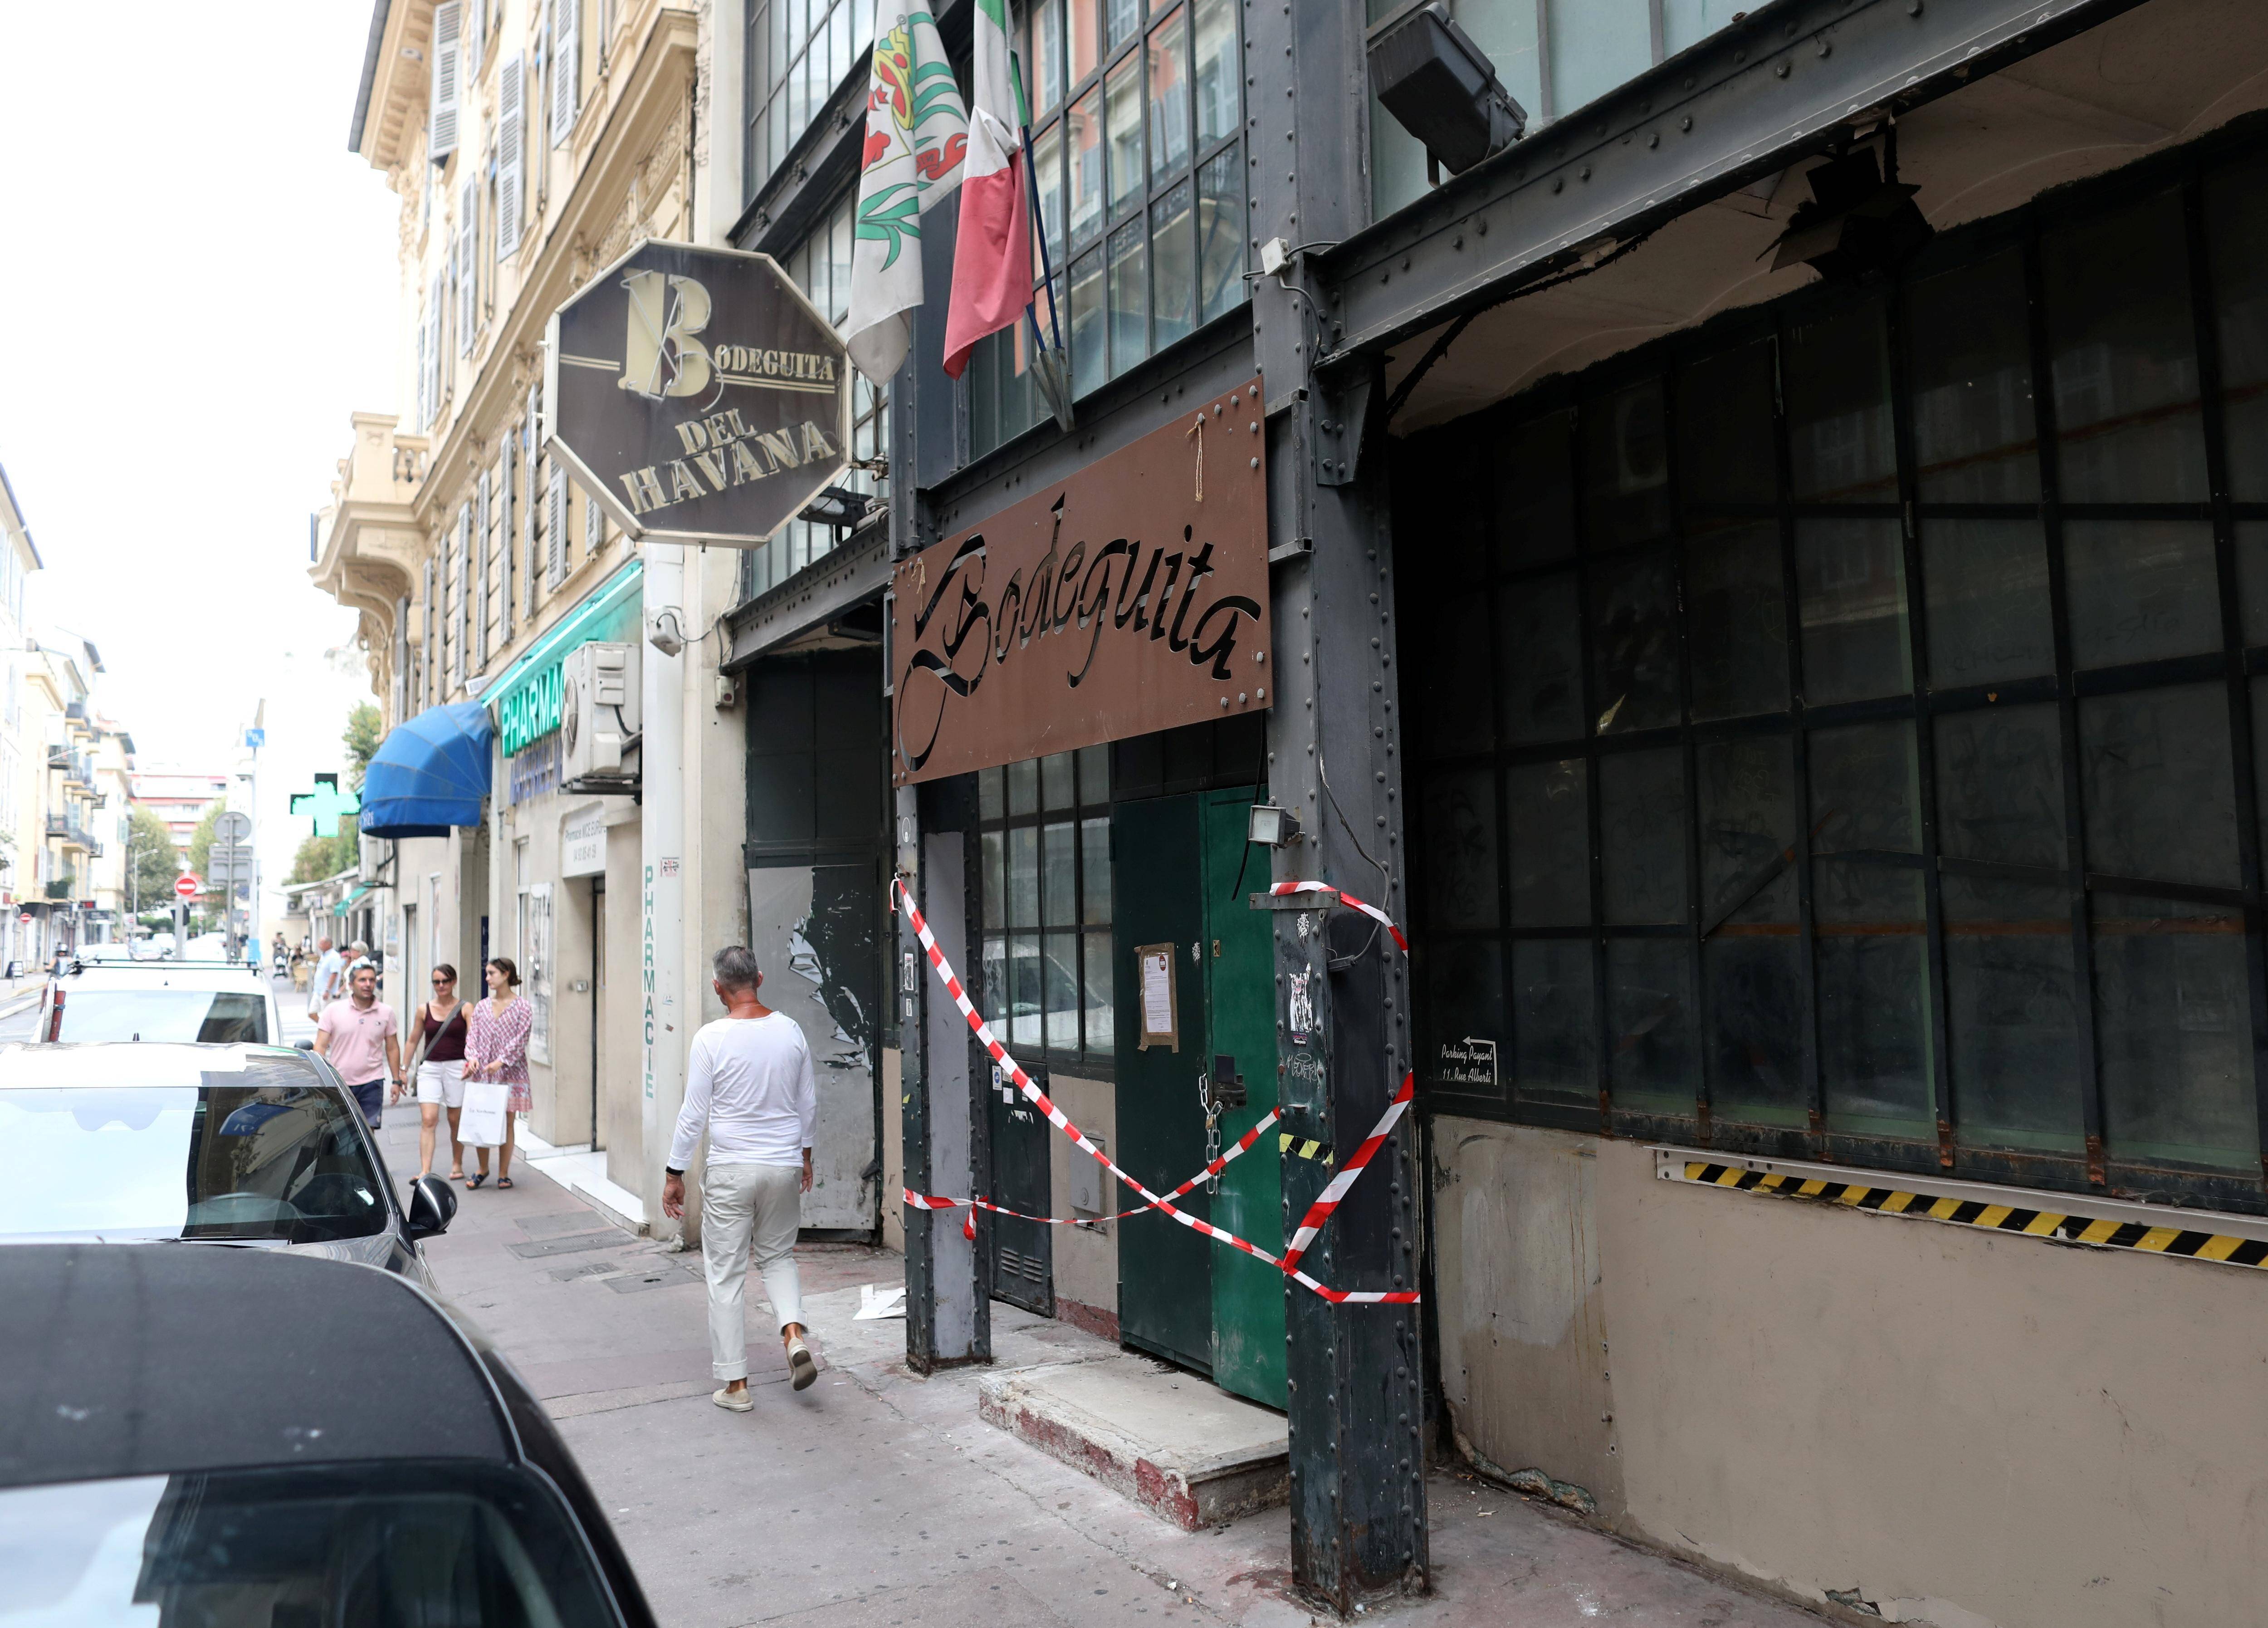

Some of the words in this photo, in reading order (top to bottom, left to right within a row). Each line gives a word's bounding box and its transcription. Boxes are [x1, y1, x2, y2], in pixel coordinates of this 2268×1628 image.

[675, 408, 757, 455] DEL
[620, 420, 836, 515] HAVANA
[898, 491, 1261, 771] Bodeguita
[643, 865, 655, 1098] PHARMACIE
[1442, 1044, 1467, 1064] Parking
[1469, 1045, 1492, 1065] Payant
[1455, 1067, 1466, 1081] Rue
[1468, 1068, 1491, 1083] Alberti
